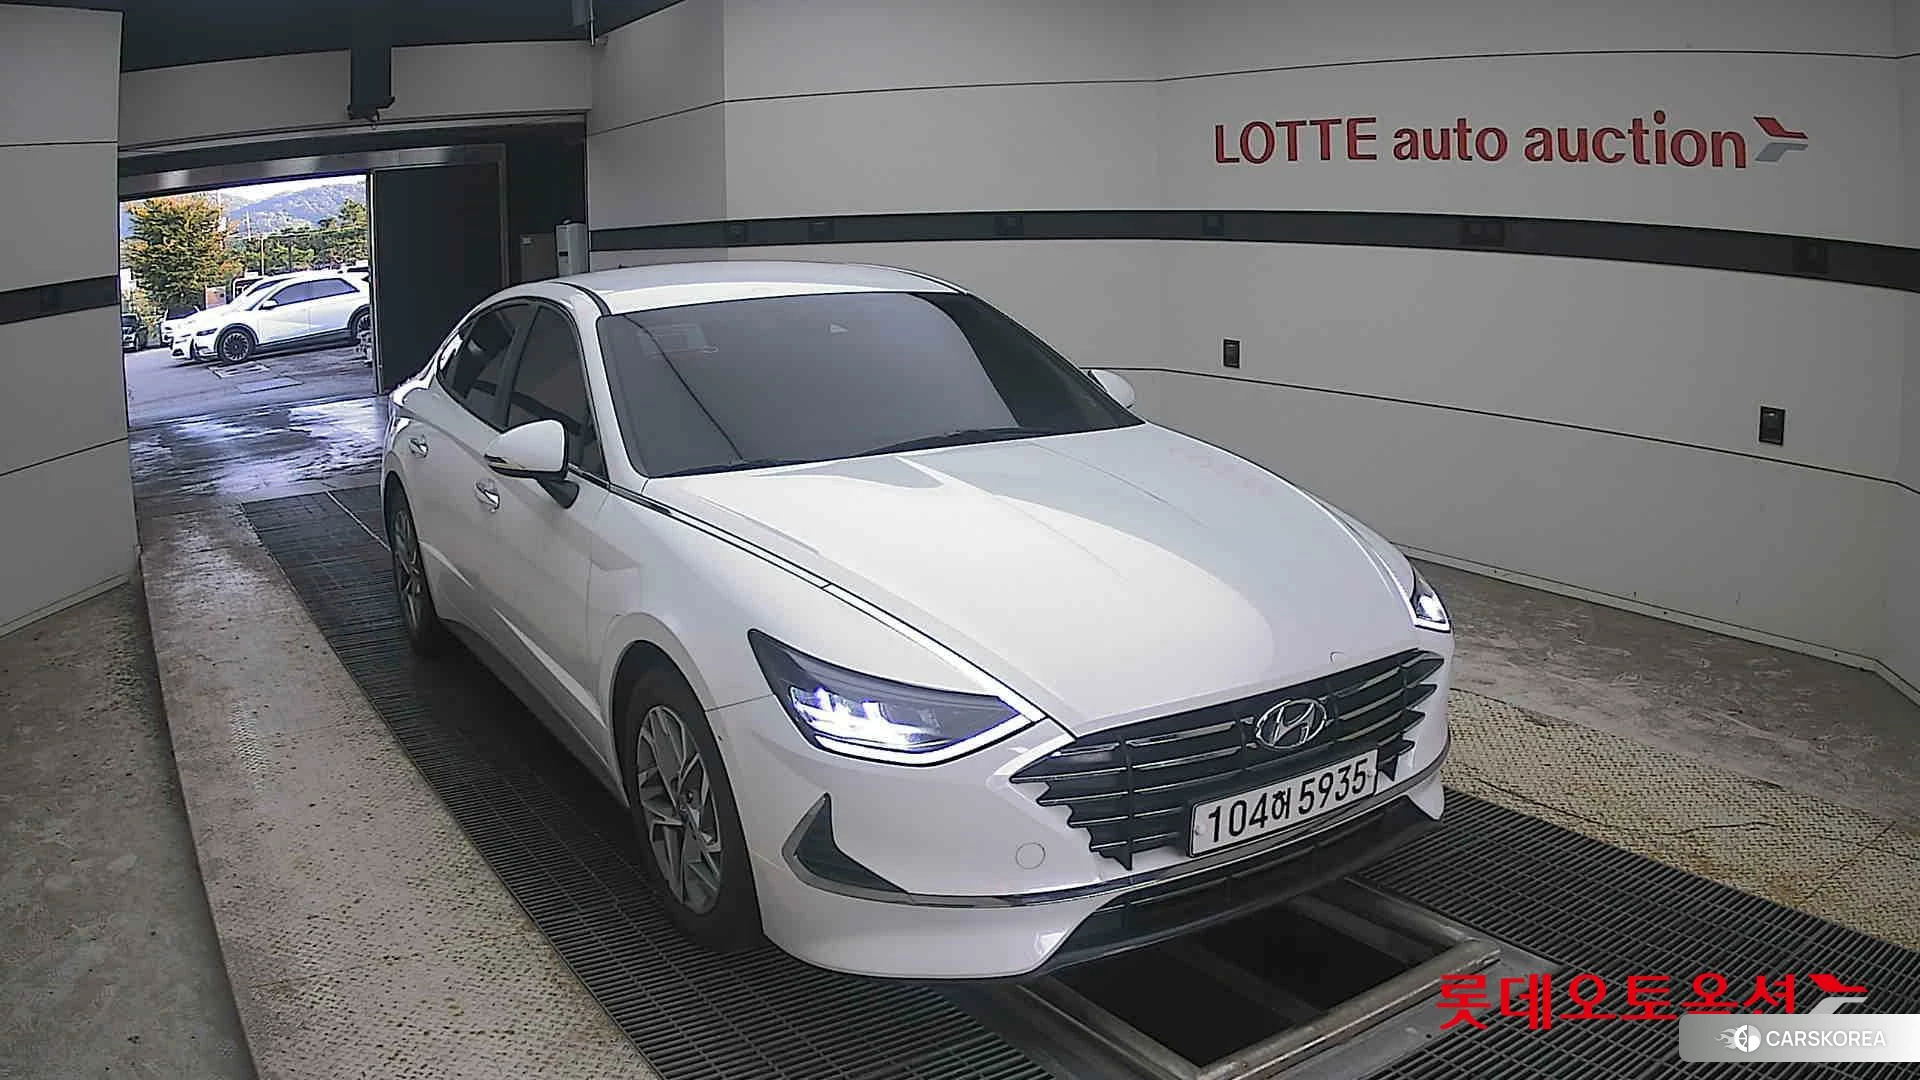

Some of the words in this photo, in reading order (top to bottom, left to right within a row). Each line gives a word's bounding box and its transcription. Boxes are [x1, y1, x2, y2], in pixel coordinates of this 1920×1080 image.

[1214, 117, 1378, 165] LOTTE
[1392, 117, 1509, 163] auto
[1523, 109, 1749, 169] auction
[1208, 787, 1292, 843] 104허
[1298, 758, 1368, 815] 5935
